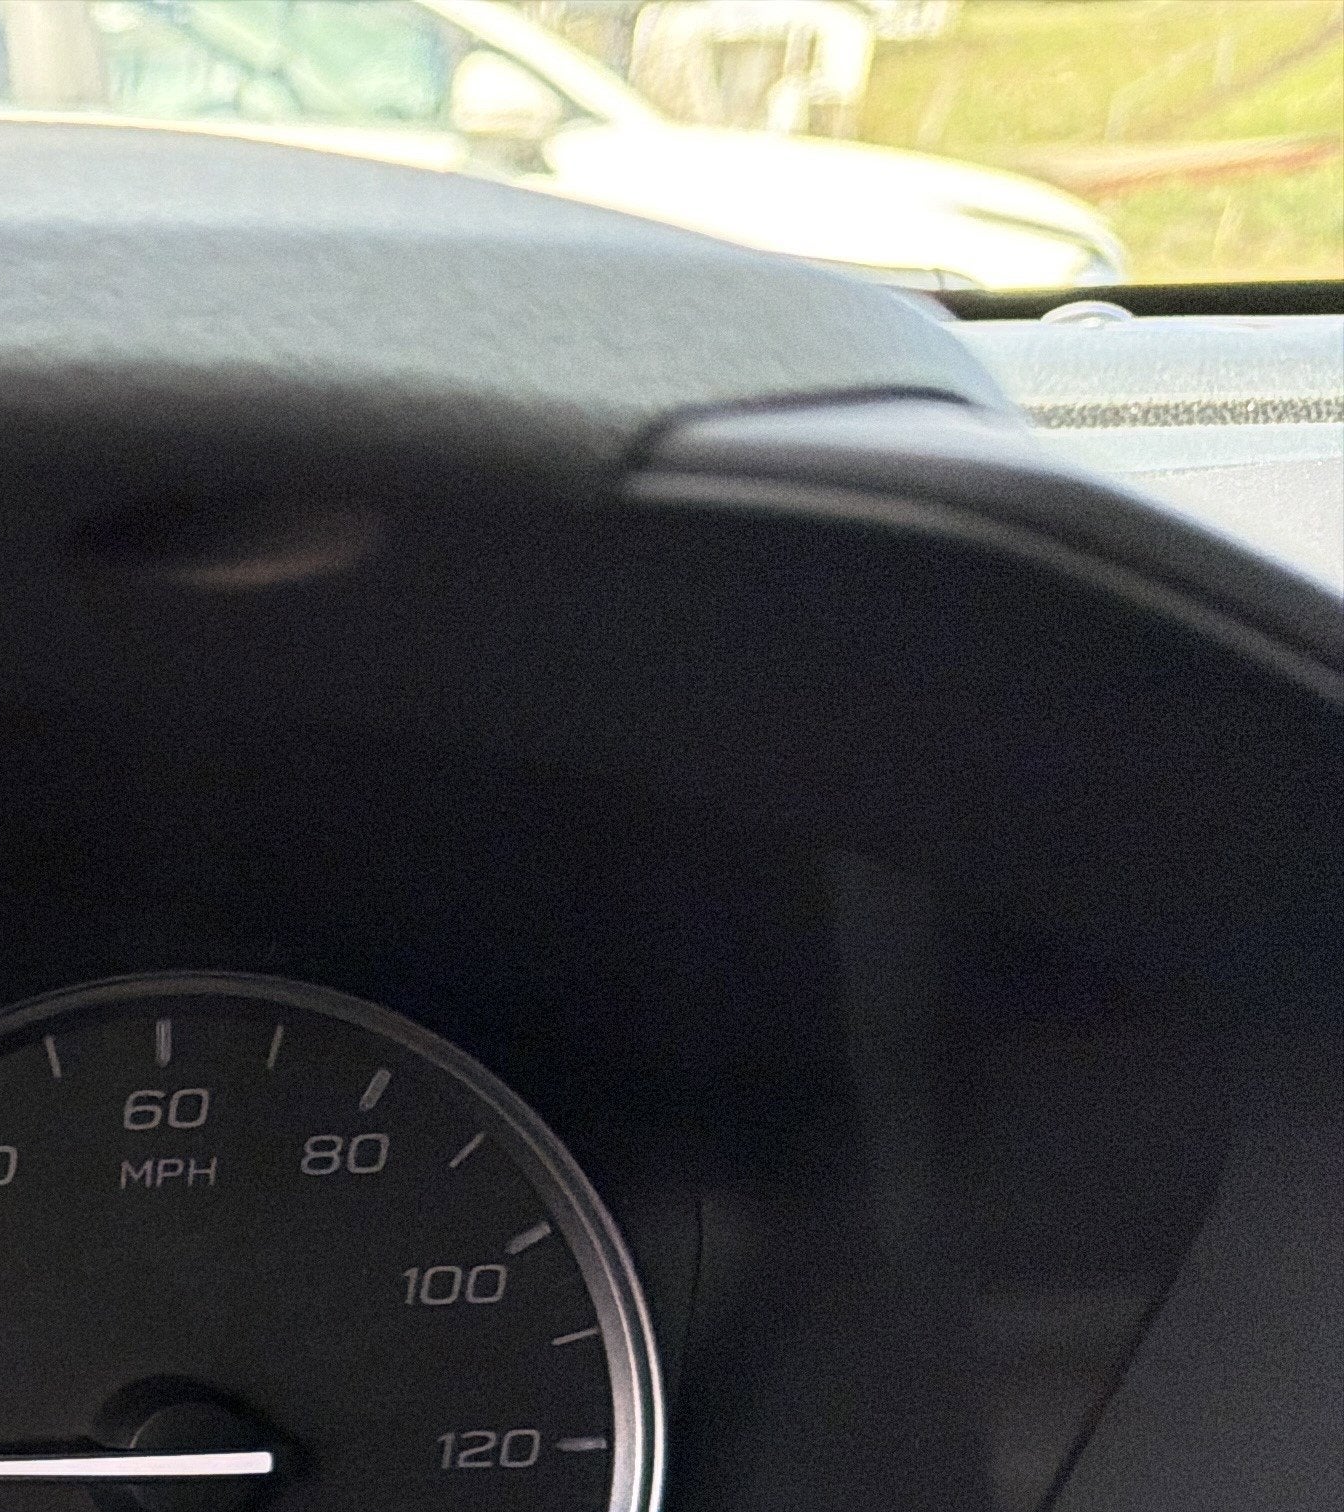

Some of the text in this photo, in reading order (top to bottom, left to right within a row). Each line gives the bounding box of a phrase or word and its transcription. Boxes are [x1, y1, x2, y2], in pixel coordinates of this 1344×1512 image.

[123, 1088, 210, 1131] 60
[120, 1157, 218, 1189] MPH
[300, 1132, 390, 1176] 80
[402, 1263, 508, 1305] 100
[436, 1428, 541, 1469] 120
